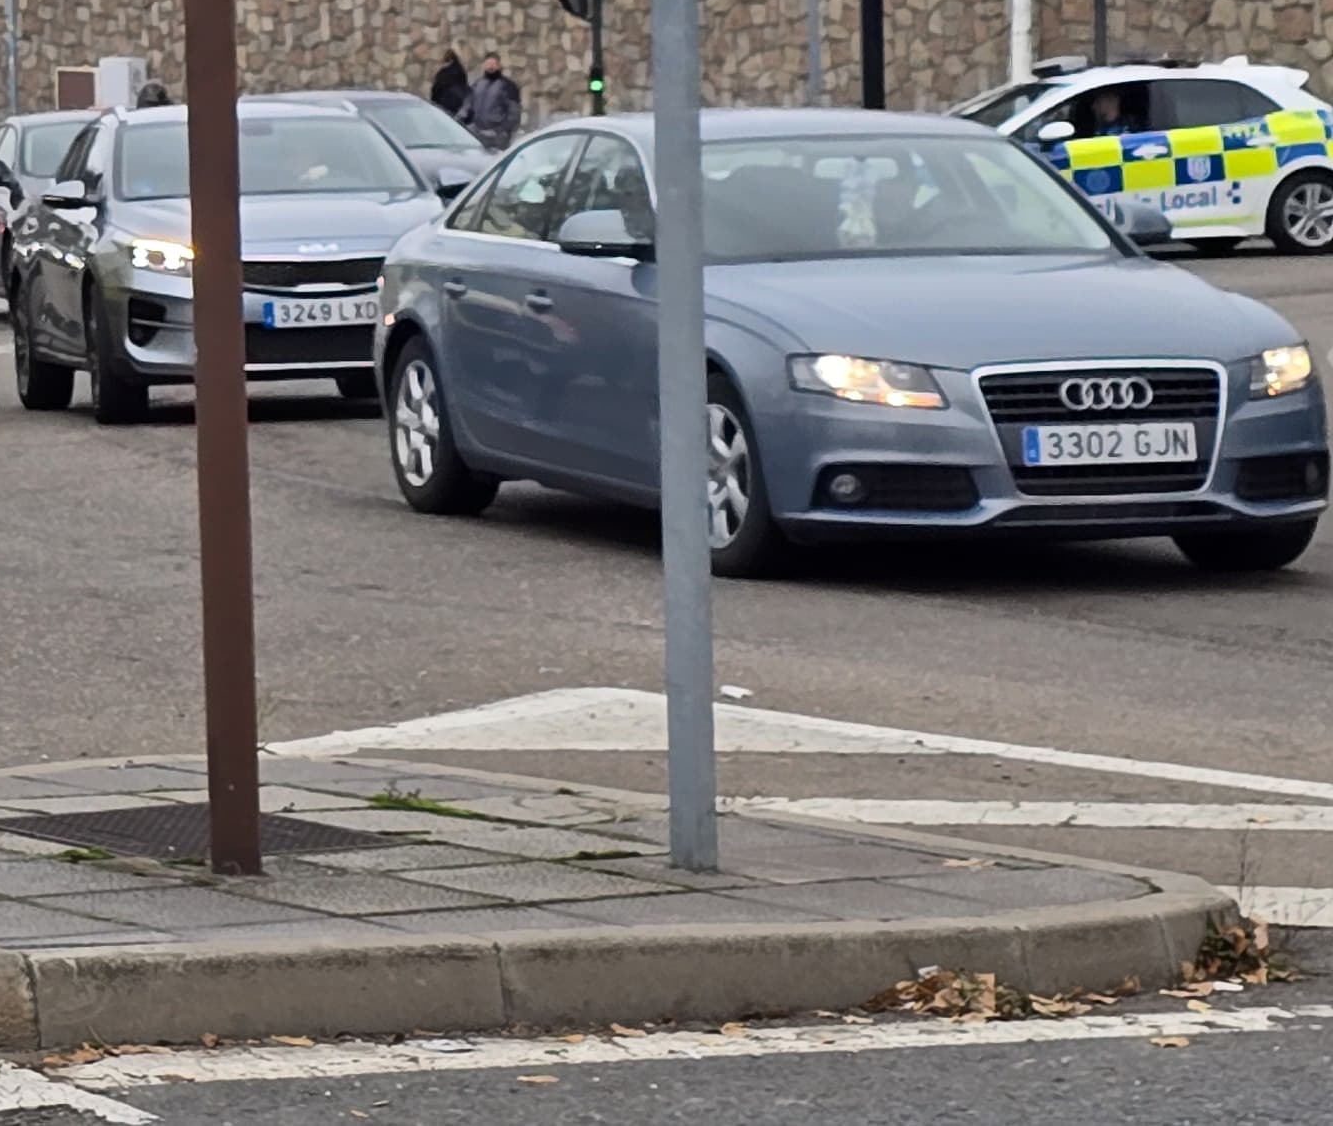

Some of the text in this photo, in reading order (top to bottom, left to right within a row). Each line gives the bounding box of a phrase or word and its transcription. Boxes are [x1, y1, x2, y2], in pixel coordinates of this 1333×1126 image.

[1161, 186, 1217, 212] Local
[281, 303, 332, 323] 3249
[1047, 428, 1188, 459] 3302 GJN
